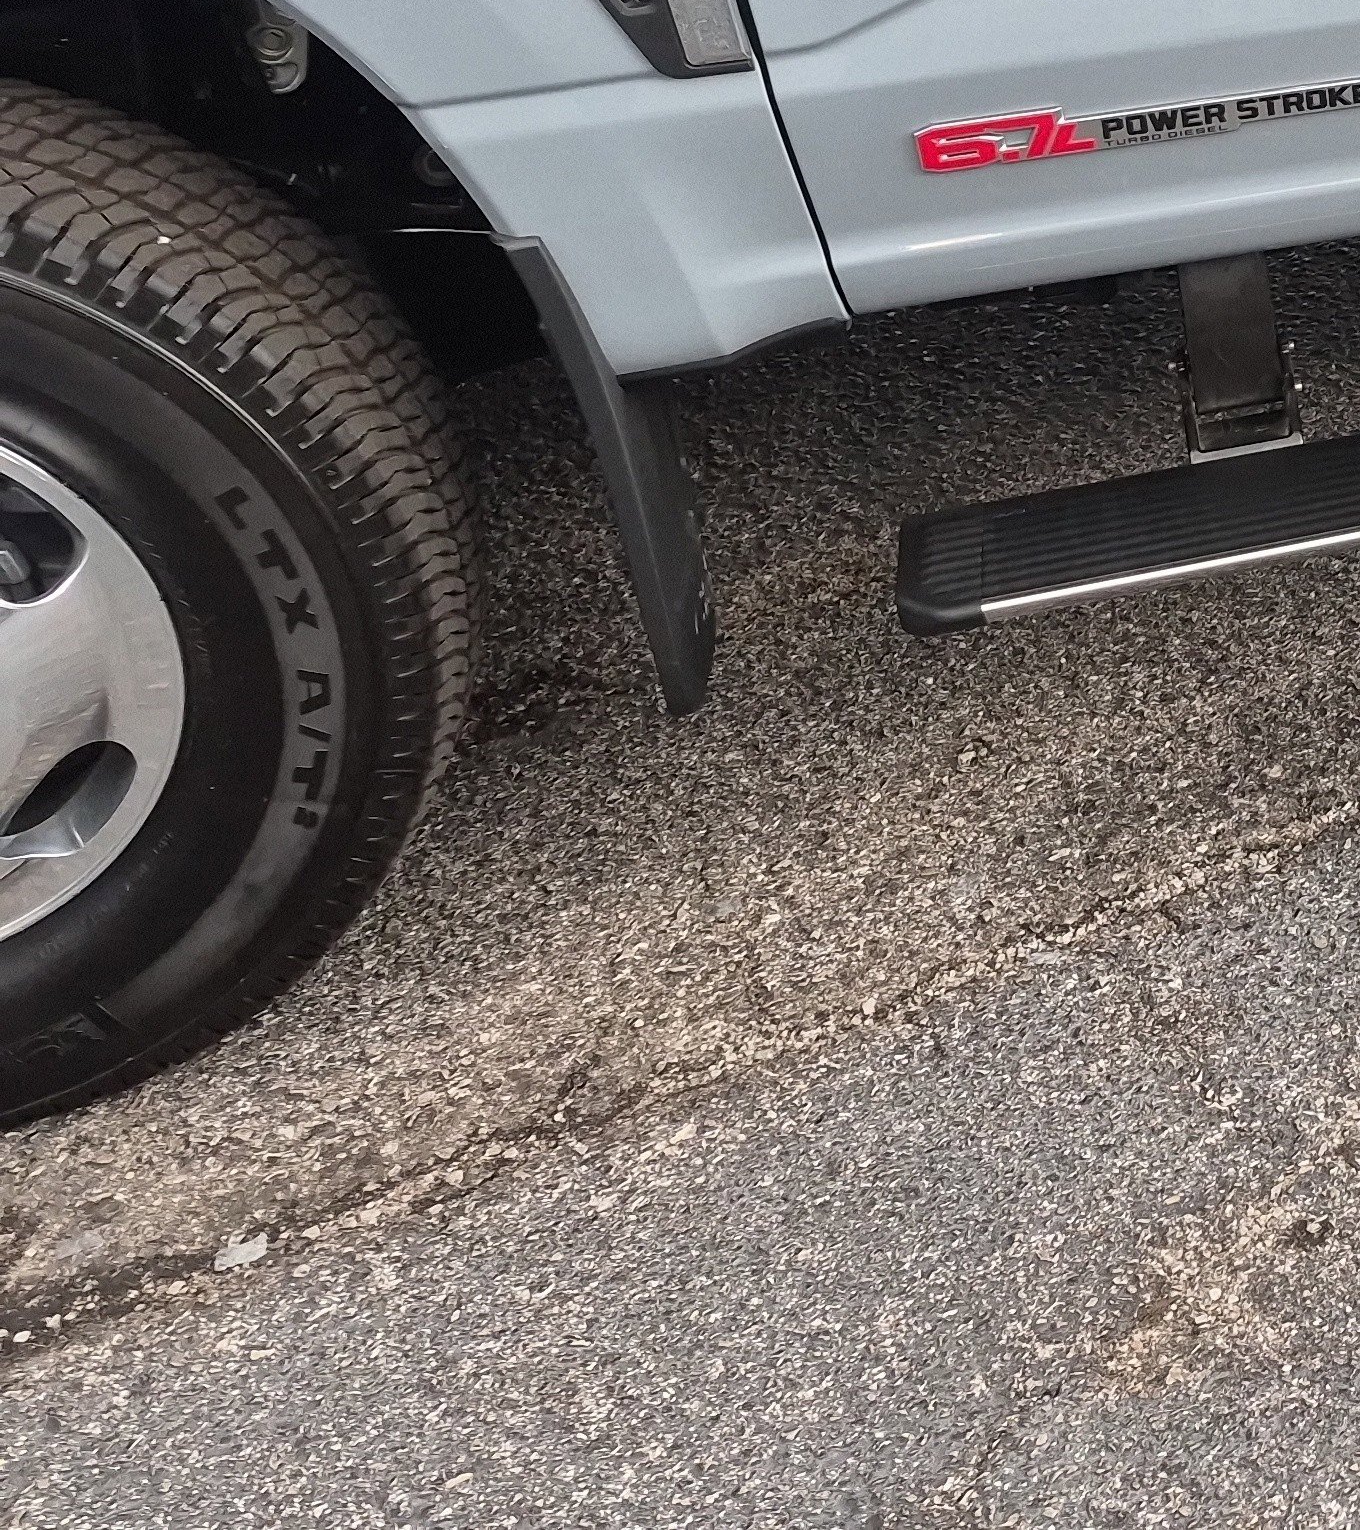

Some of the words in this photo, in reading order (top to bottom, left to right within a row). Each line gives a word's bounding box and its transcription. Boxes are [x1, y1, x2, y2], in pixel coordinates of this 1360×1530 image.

[914, 112, 1098, 172] 6.7L
[1102, 103, 1226, 140] POWER
[1104, 132, 1161, 147] TURBO
[1168, 124, 1229, 138] DIESEL
[214, 485, 320, 636] LTX
